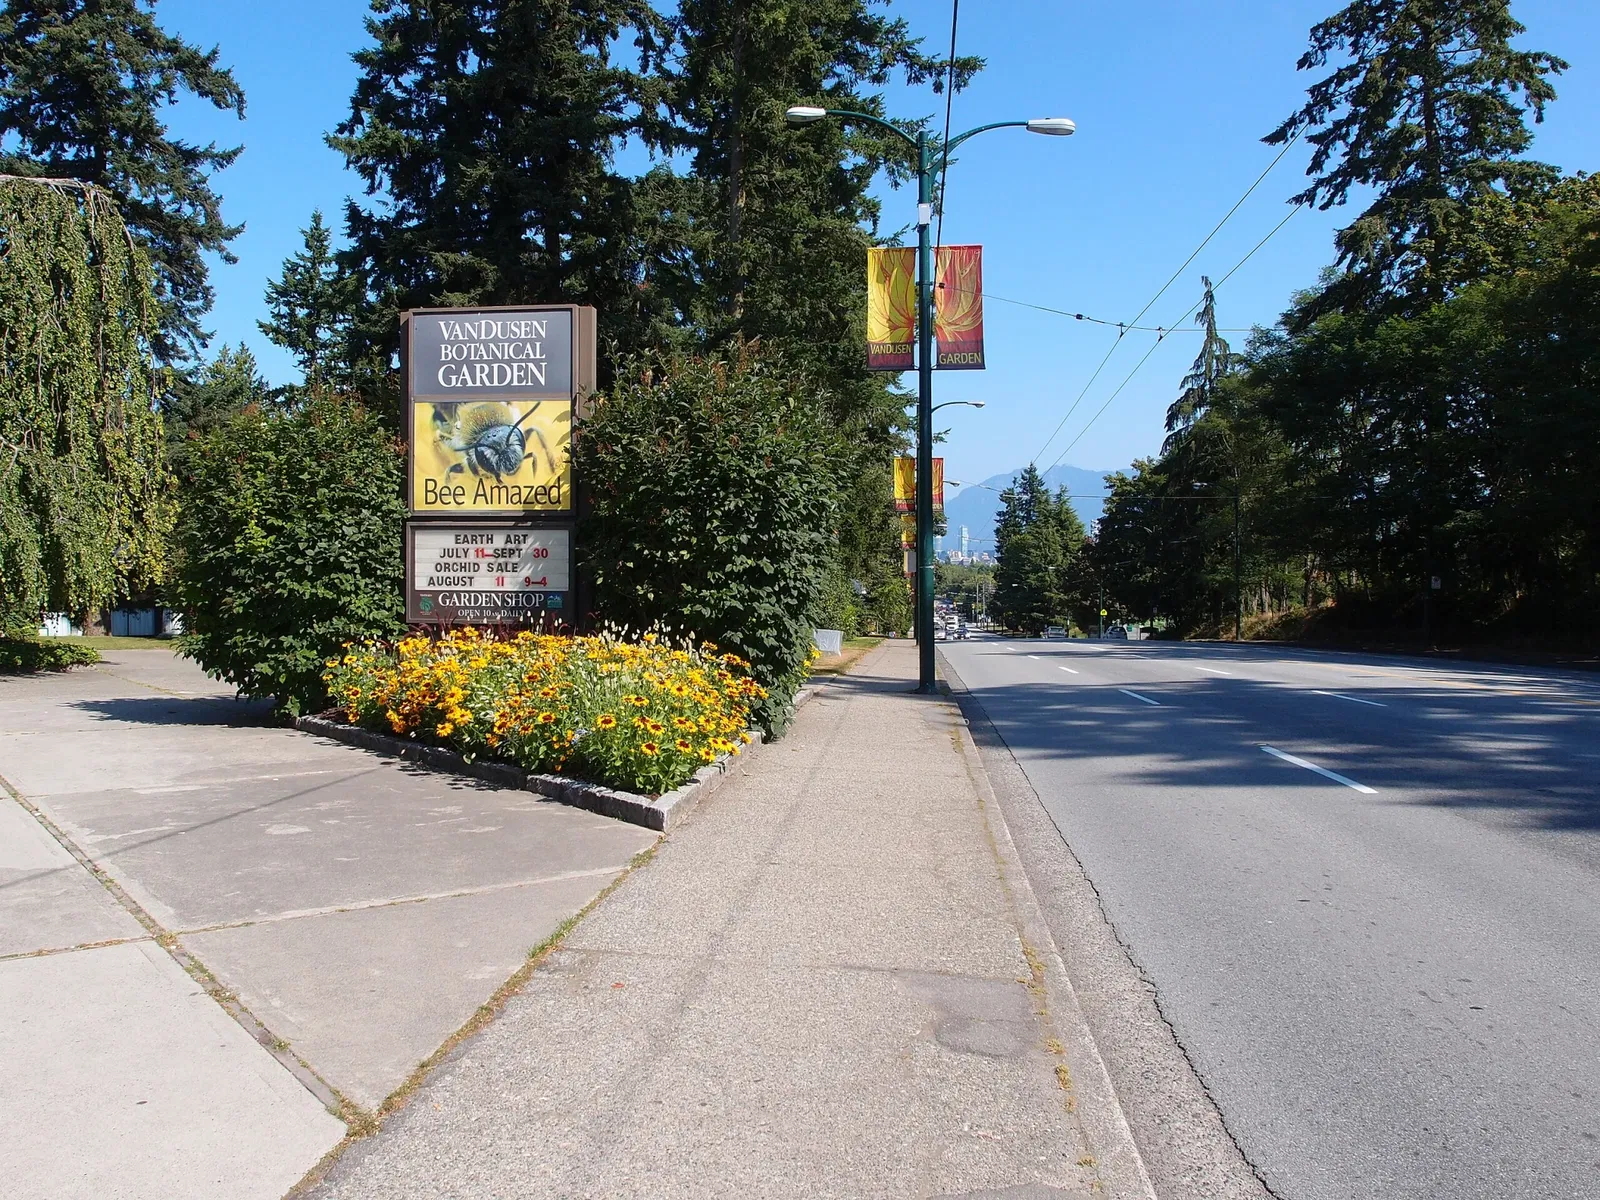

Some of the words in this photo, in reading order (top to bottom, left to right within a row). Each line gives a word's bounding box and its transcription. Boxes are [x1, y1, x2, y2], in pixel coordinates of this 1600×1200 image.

[438, 320, 548, 340] VANDUSEN
[440, 342, 546, 361] BOTANICAL
[870, 343, 912, 354] VANDUSEN
[939, 353, 982, 365] GARDEN
[437, 363, 548, 387] GARDEN
[424, 478, 466, 505] Bee
[473, 476, 561, 505] Amazed
[454, 534, 494, 544] EARTH
[504, 534, 528, 544] ART
[440, 548, 470, 558] JULY
[533, 548, 549, 558] 30
[434, 562, 480, 573] ORCHID
[486, 562, 519, 573] SALE
[427, 576, 474, 587] AUGUST
[495, 576, 505, 587] 11
[458, 609, 481, 617] OPEN
